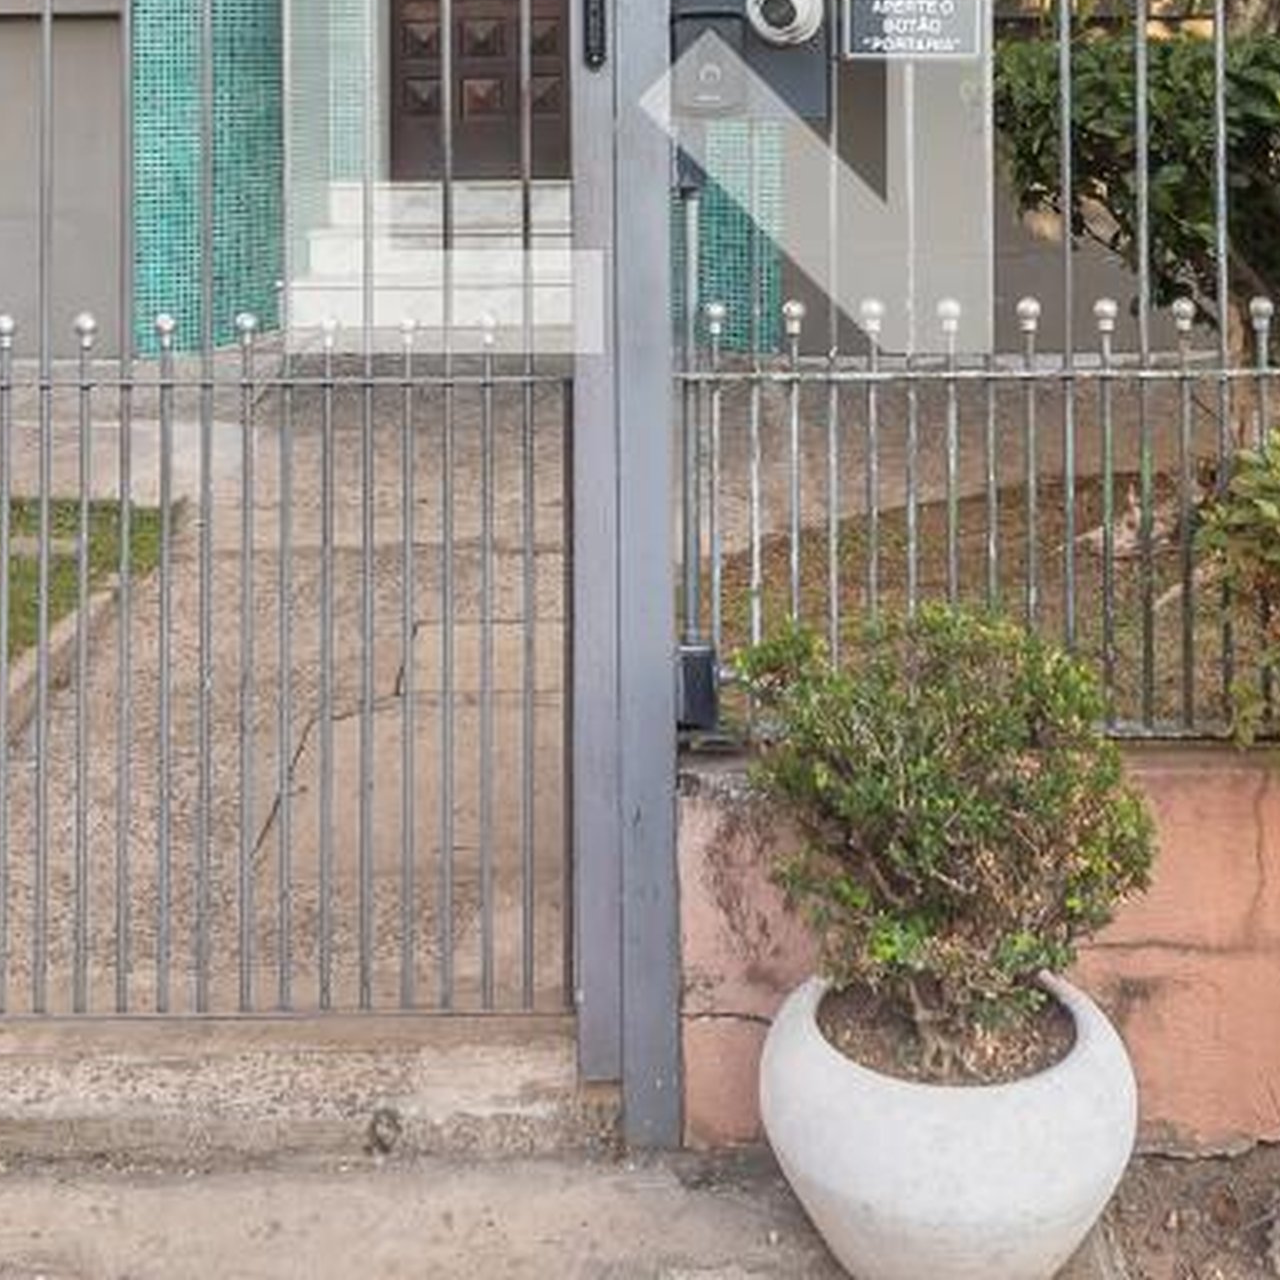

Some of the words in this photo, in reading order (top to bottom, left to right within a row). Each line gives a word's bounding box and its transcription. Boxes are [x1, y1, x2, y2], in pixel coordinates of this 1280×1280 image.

[872, 0, 938, 15] APERTE
[940, 0, 955, 16] O
[883, 16, 941, 35] BOTÃO
